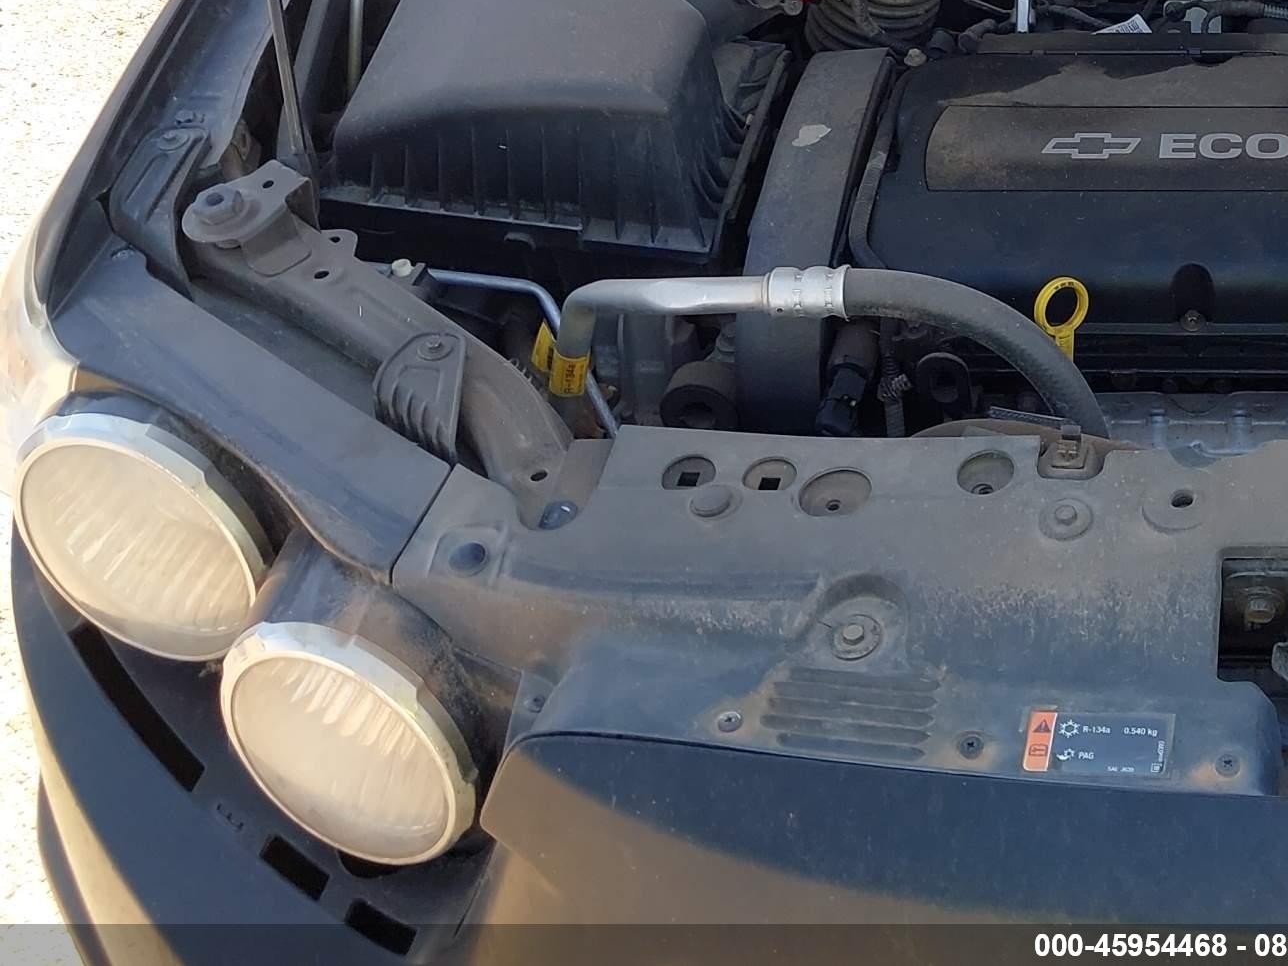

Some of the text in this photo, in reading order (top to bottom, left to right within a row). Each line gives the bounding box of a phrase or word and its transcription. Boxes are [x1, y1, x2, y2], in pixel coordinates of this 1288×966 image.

[1083, 726, 1158, 737] R-134a 0.540 kg
[1078, 752, 1094, 760] PAG
